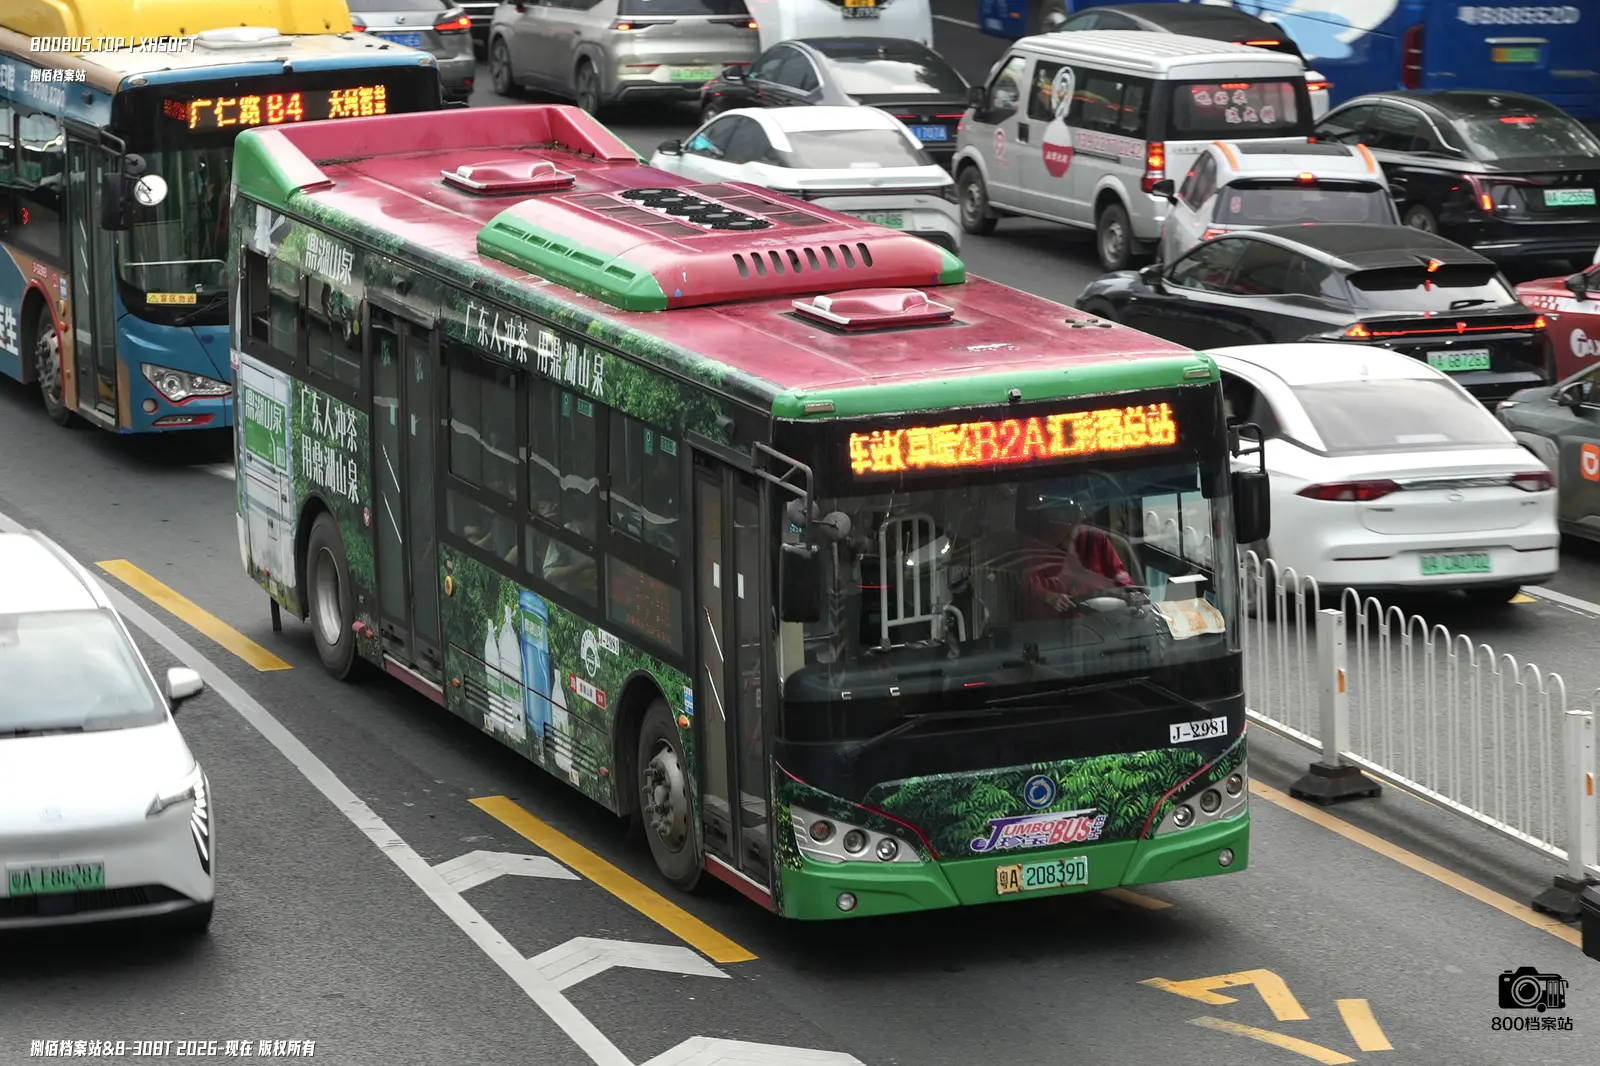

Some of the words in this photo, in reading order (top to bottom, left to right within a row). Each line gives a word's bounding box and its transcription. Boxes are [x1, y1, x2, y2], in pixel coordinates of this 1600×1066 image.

[267, 93, 302, 123] B4
[305, 233, 355, 285] 鼎湖山泉
[465, 301, 529, 364] 广东人冲茶
[536, 330, 604, 396] 用鼎湖山泉
[245, 390, 282, 434] 鼎湖山泉
[301, 385, 358, 453] 广东人冲茶
[301, 433, 359, 505] 用鼎湖山泉
[1172, 720, 1226, 740] J-2981
[970, 817, 1056, 852] JUMBO
[1048, 817, 1095, 844] BUS
[1026, 861, 1086, 886] 20839D
